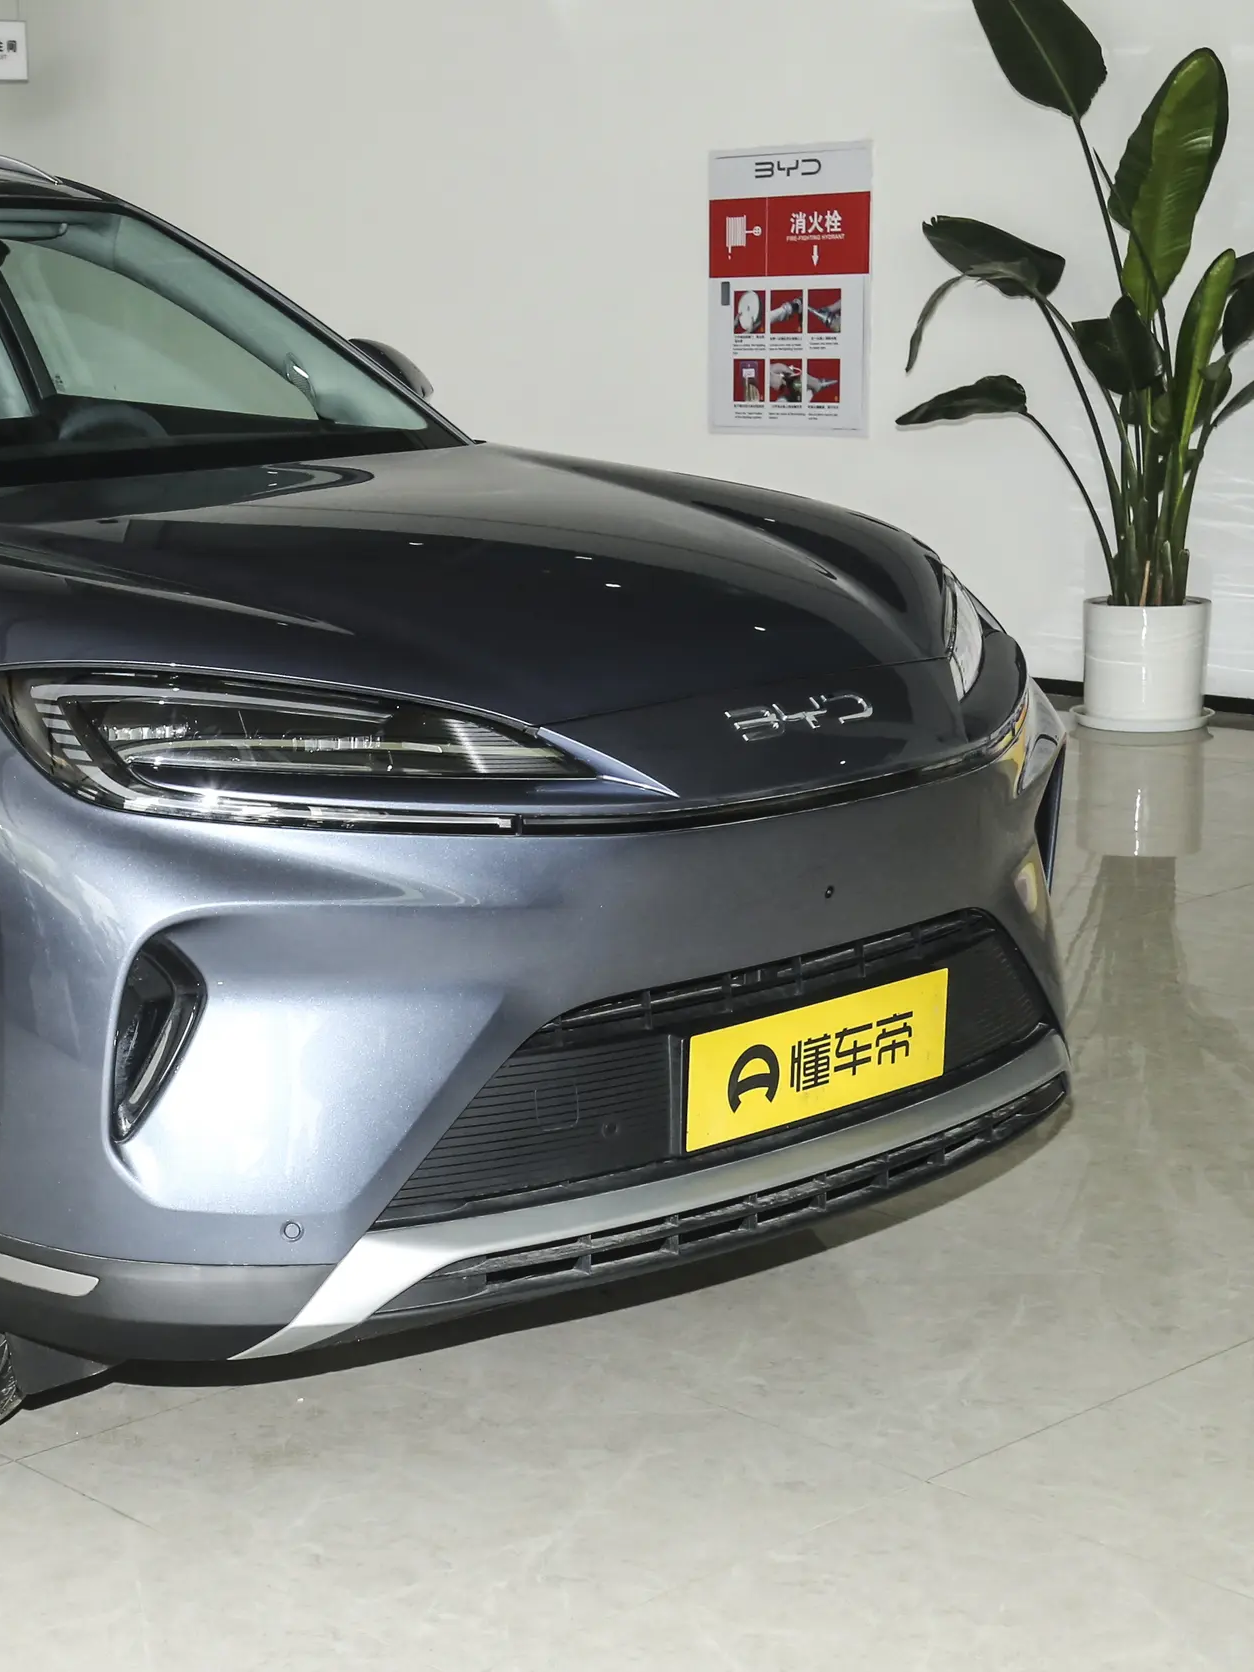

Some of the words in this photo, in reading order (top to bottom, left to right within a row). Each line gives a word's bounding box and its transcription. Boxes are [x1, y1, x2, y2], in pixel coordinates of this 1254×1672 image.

[755, 158, 821, 178] BYD
[790, 210, 842, 234] 消火栓
[724, 694, 873, 742] BYD
[789, 1011, 913, 1093] 懂车帝
